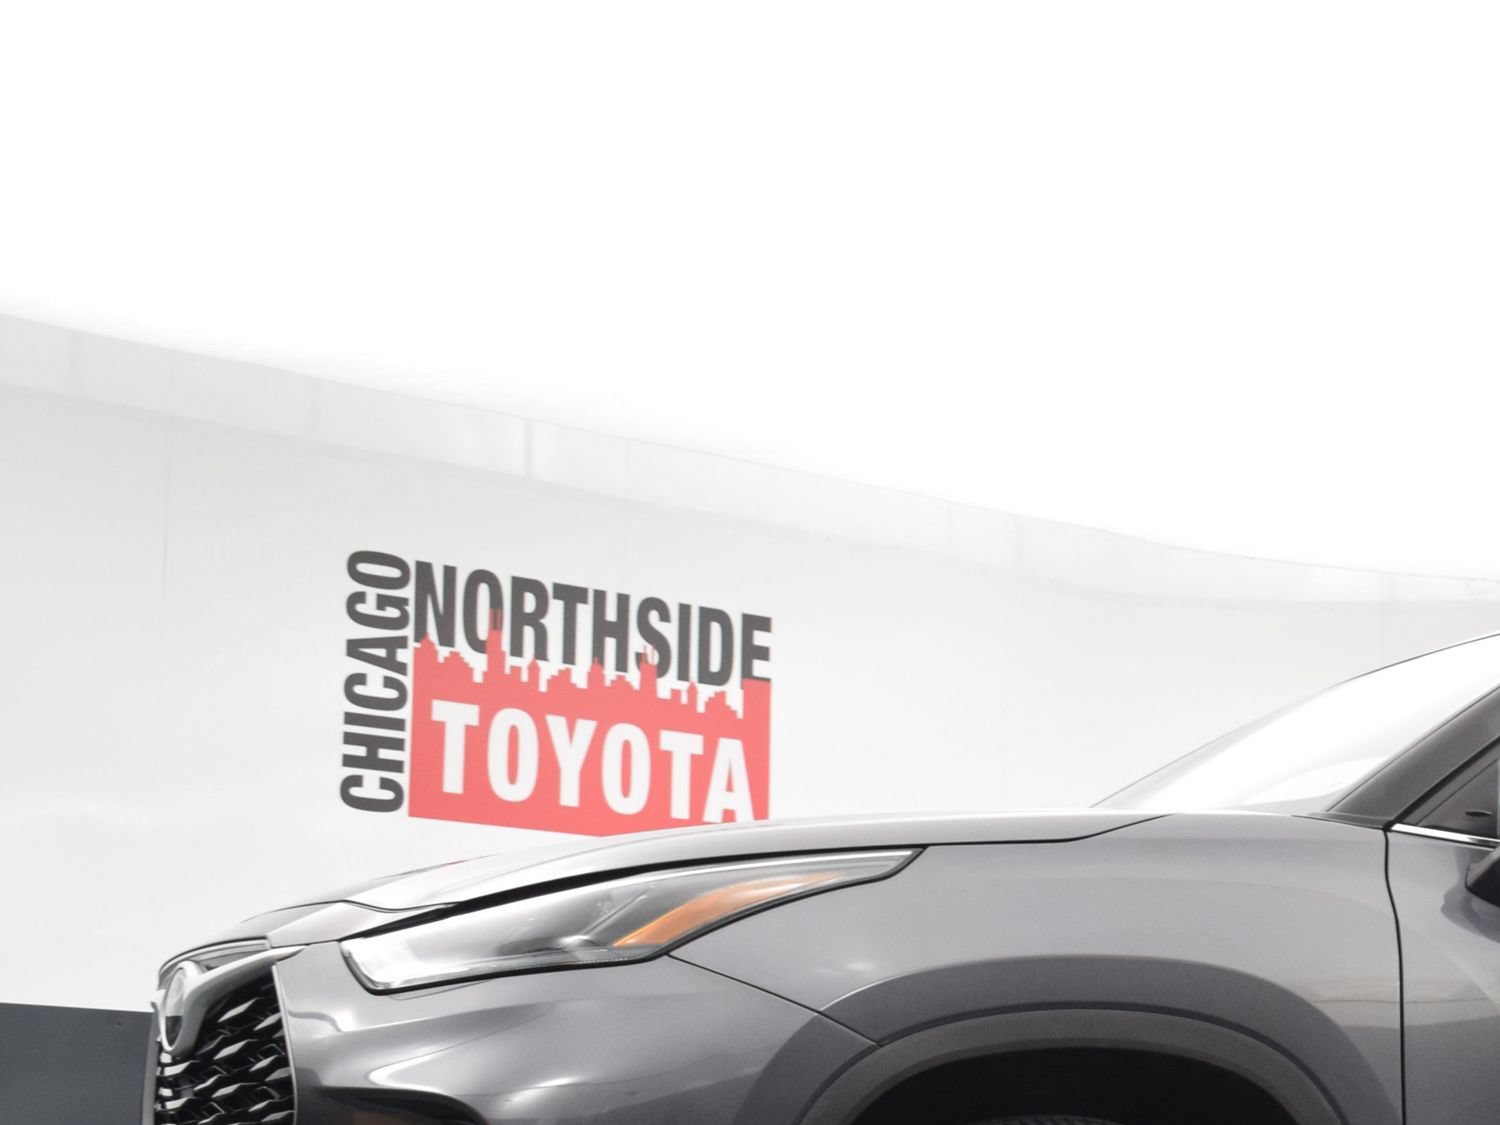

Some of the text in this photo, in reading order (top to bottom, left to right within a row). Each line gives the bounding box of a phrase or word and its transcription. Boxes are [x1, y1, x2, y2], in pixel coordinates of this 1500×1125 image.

[340, 550, 410, 813] CHICAGO
[413, 560, 772, 688] NORTHSIDE
[431, 699, 754, 823] TOYOTA
